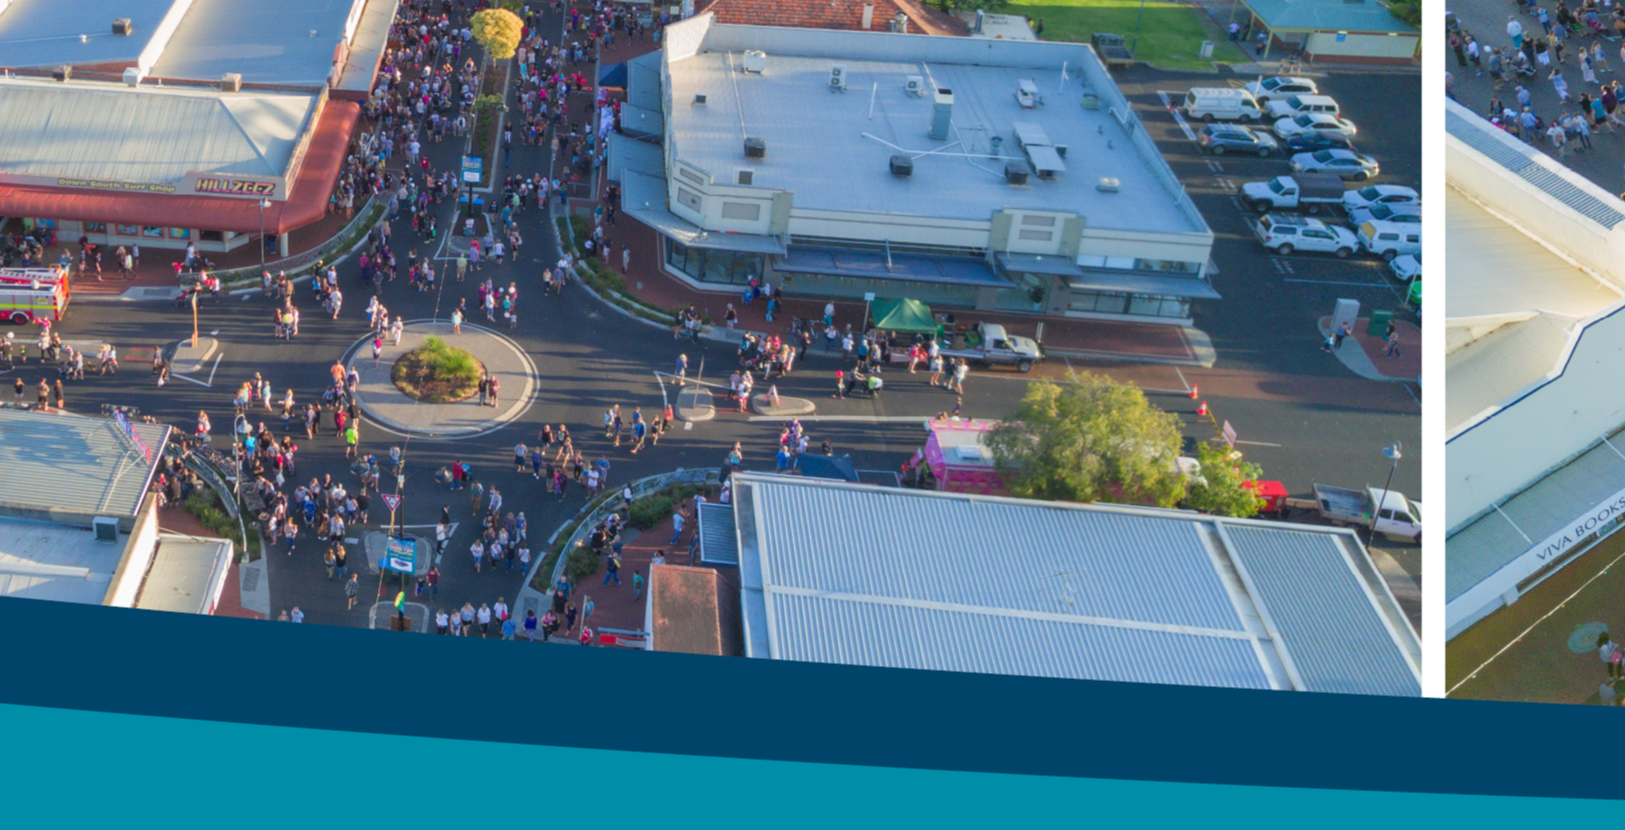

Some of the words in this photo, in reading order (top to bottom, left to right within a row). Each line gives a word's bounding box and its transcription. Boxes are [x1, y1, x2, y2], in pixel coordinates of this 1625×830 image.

[58, 178, 87, 187] Down
[89, 180, 121, 190] South
[123, 183, 147, 191] Surf
[149, 184, 176, 194] Shop
[195, 178, 276, 196] HILLZEEZ
[1536, 535, 1572, 560] VIVA
